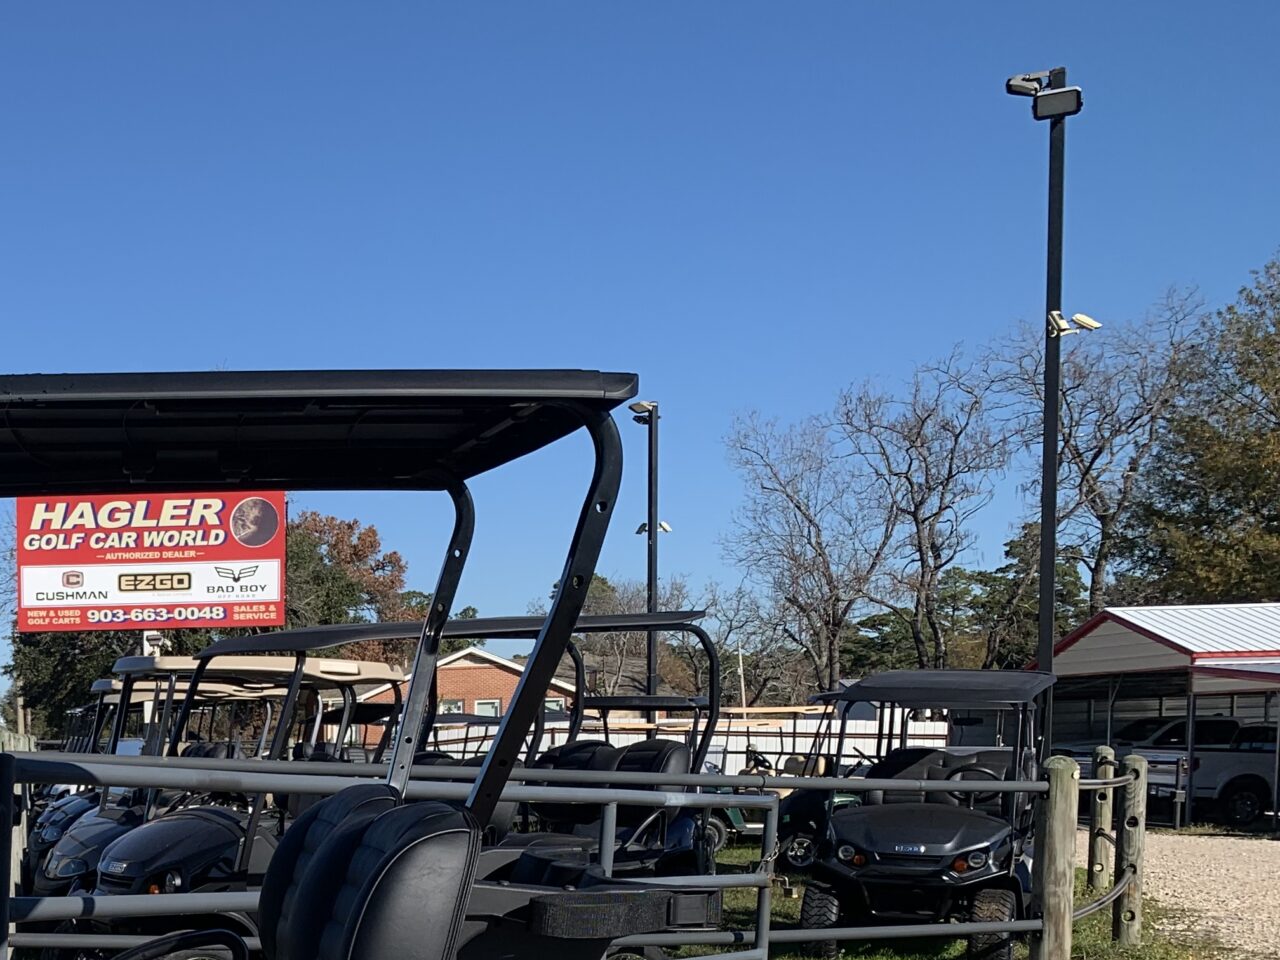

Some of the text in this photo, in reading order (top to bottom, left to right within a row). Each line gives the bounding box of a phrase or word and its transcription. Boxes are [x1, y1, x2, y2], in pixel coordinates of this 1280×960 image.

[30, 498, 224, 530] HAGLER
[23, 529, 225, 550] GOLF CAR WORLD
[105, 550, 197, 560] AUTHORIZED DEALER
[35, 591, 108, 601] CUSHMAN
[233, 604, 265, 612] SALES
[87, 606, 225, 622] 903-663-0048
[233, 612, 277, 620] SERVICE
[52, 617, 81, 625] CARTS
